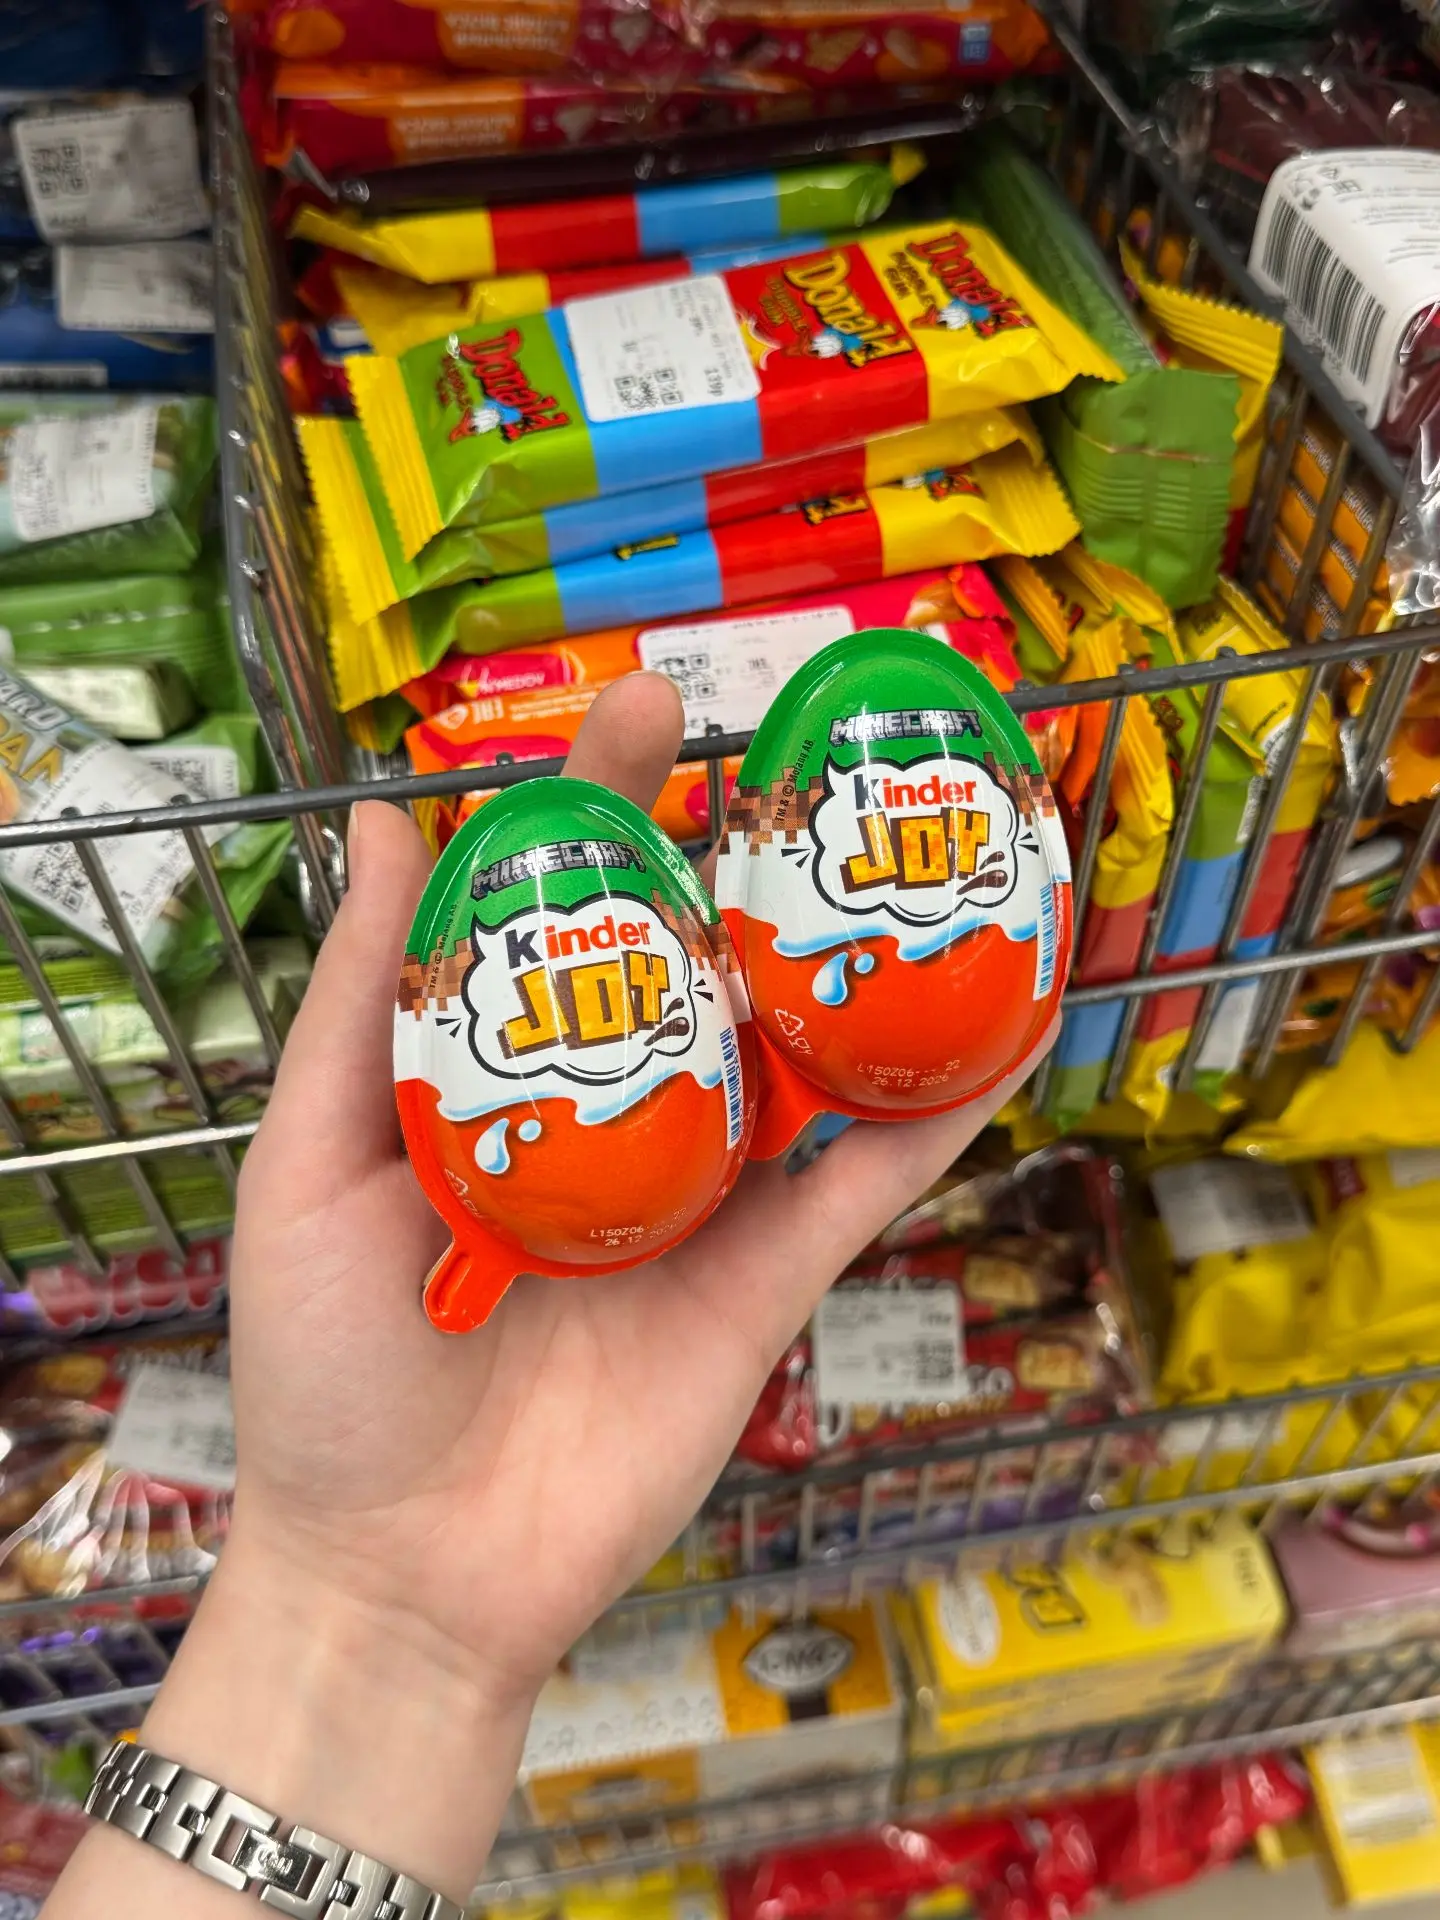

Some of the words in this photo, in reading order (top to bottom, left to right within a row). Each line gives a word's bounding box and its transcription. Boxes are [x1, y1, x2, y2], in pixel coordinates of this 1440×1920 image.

[784, 253, 912, 368] Donald
[459, 327, 570, 441] Donald
[828, 709, 983, 747] MINECRAFT
[775, 807, 787, 821] TM
[787, 752, 810, 783] Mojang
[471, 840, 647, 901] MINECRAFT
[839, 806, 991, 894] JOY
[496, 950, 671, 1059] JOY
